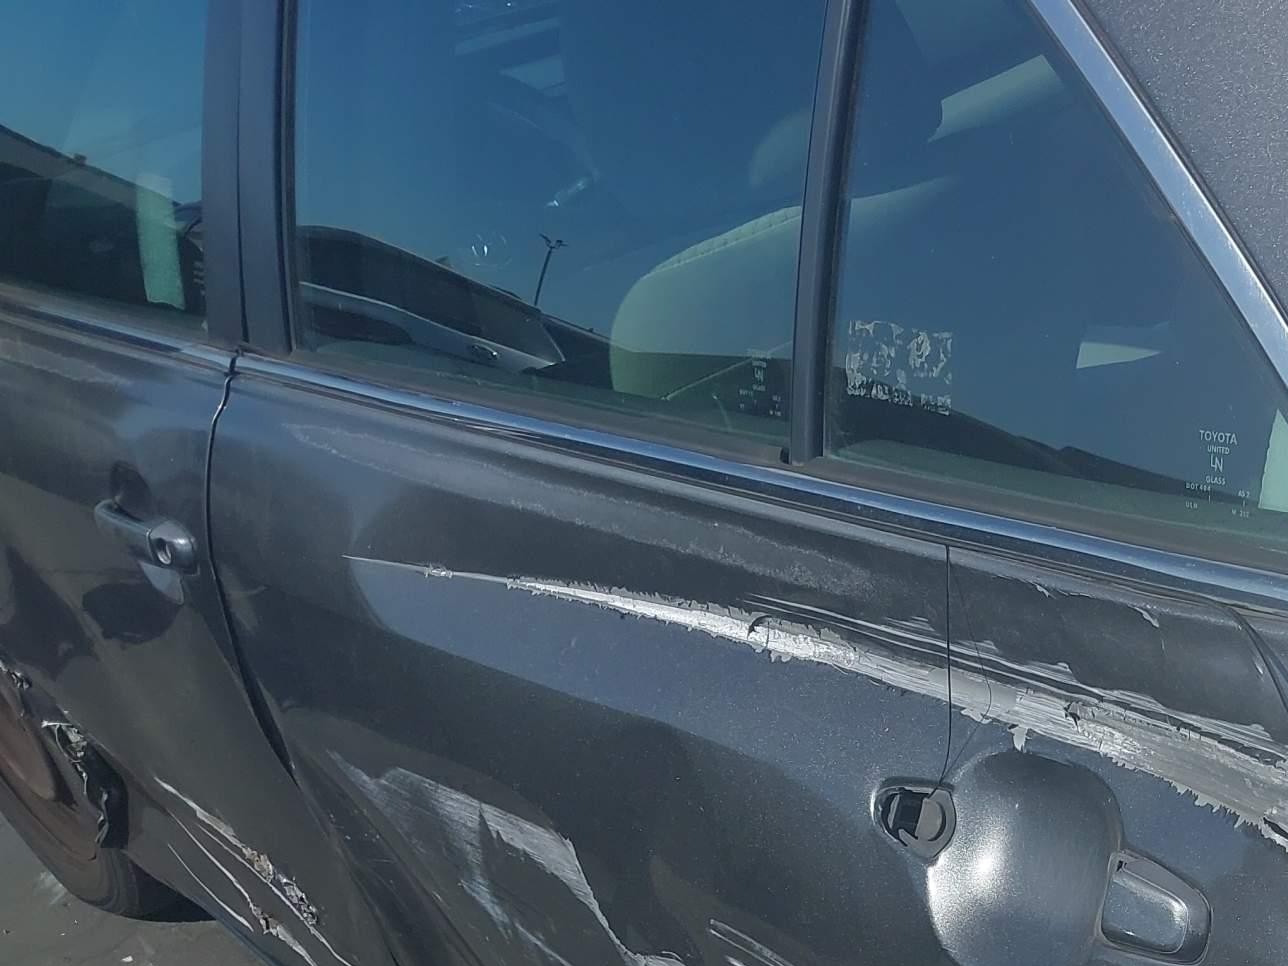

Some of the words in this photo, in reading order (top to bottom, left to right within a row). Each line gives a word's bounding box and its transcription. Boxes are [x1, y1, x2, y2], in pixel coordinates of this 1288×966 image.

[1199, 429, 1238, 445] TOYOTA
[1207, 444, 1230, 455] UNITED
[1206, 476, 1226, 485] GLASS
